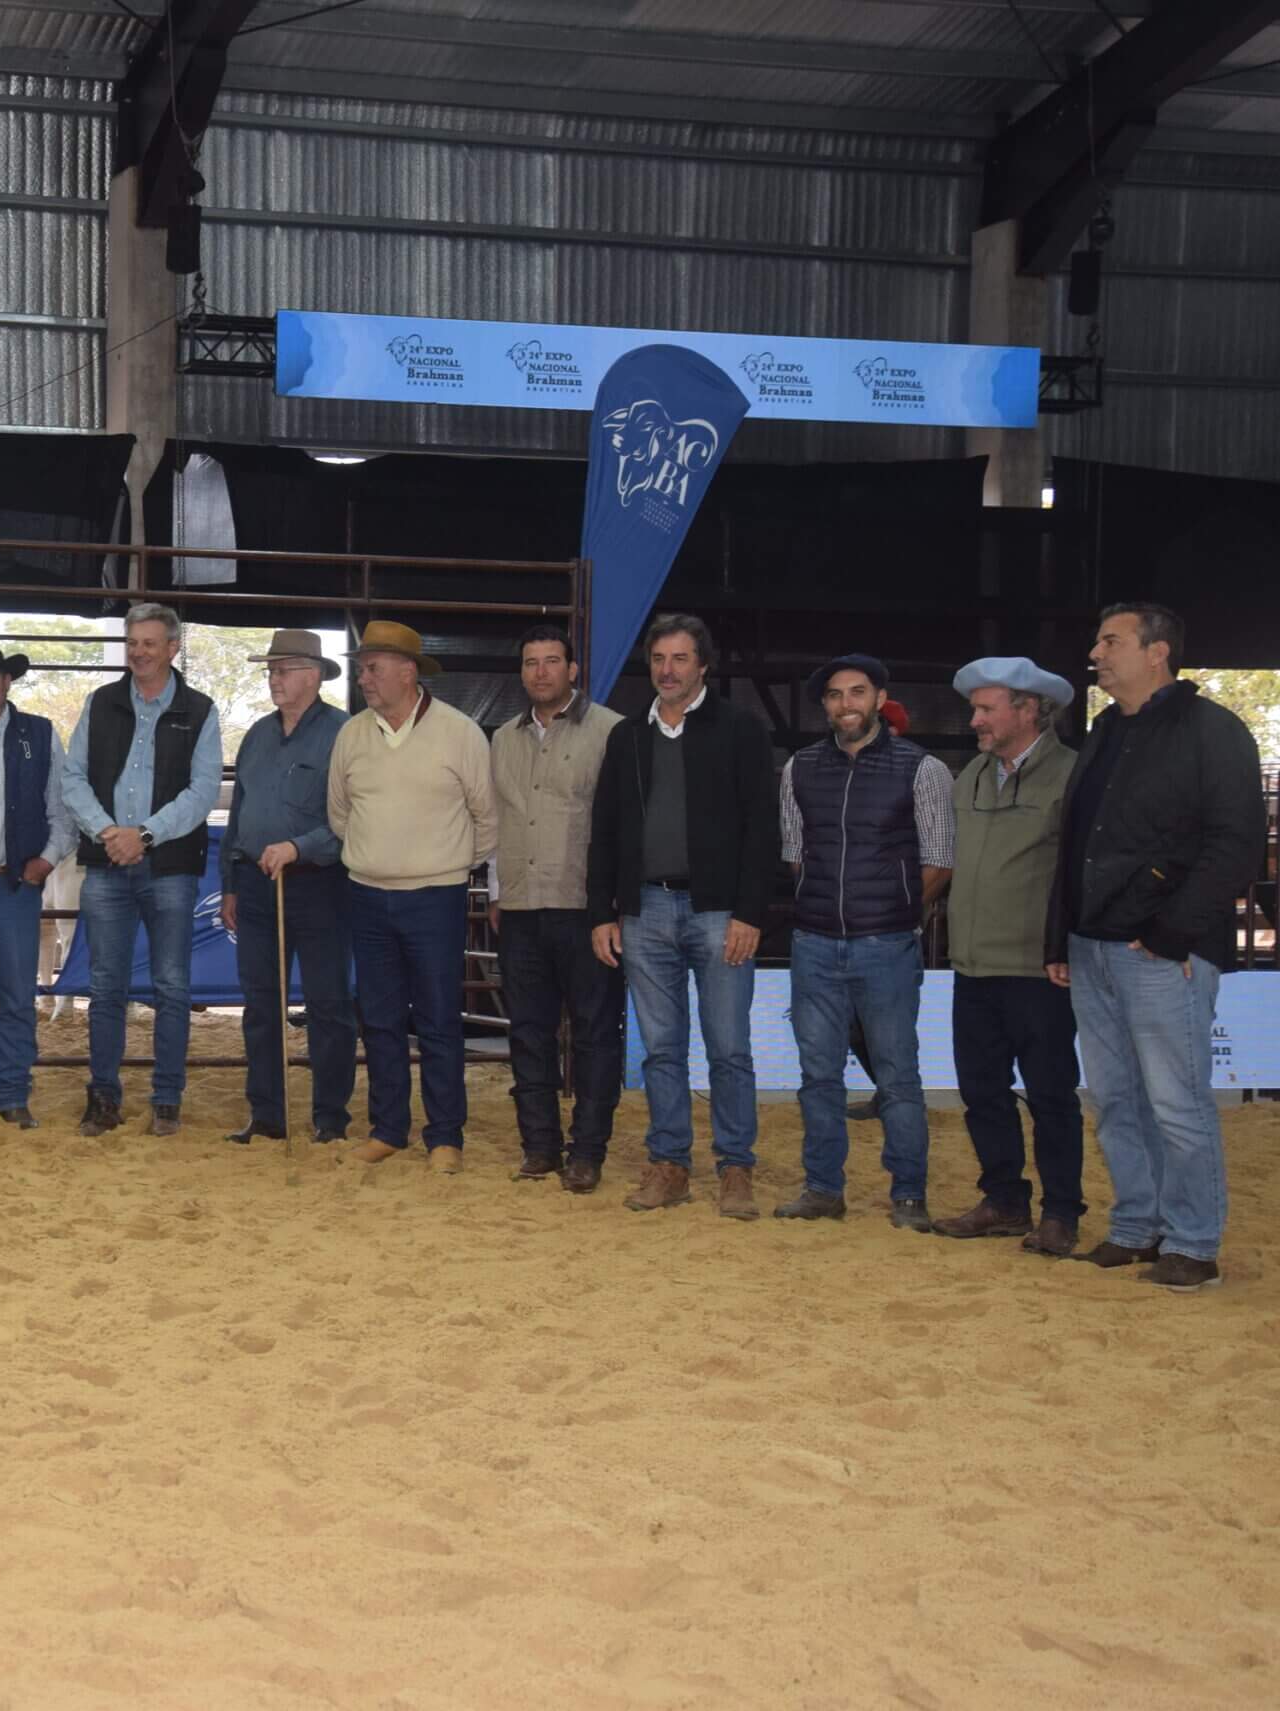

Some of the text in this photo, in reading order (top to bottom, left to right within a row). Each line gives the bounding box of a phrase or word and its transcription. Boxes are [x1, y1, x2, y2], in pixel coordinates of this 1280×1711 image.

[426, 346, 453, 355] EXPO
[545, 352, 572, 361] EXPO
[409, 357, 461, 367] NACIONAL
[529, 363, 580, 373] NACIONAL
[777, 363, 803, 373] EXPO
[890, 368, 916, 378] EXPO
[407, 368, 464, 381] Brahman
[527, 373, 583, 386] Brahman
[761, 375, 810, 384] NACIONAL
[874, 380, 923, 389] NACIONAL
[759, 384, 813, 397] Brahman
[872, 390, 925, 402] Brahman
